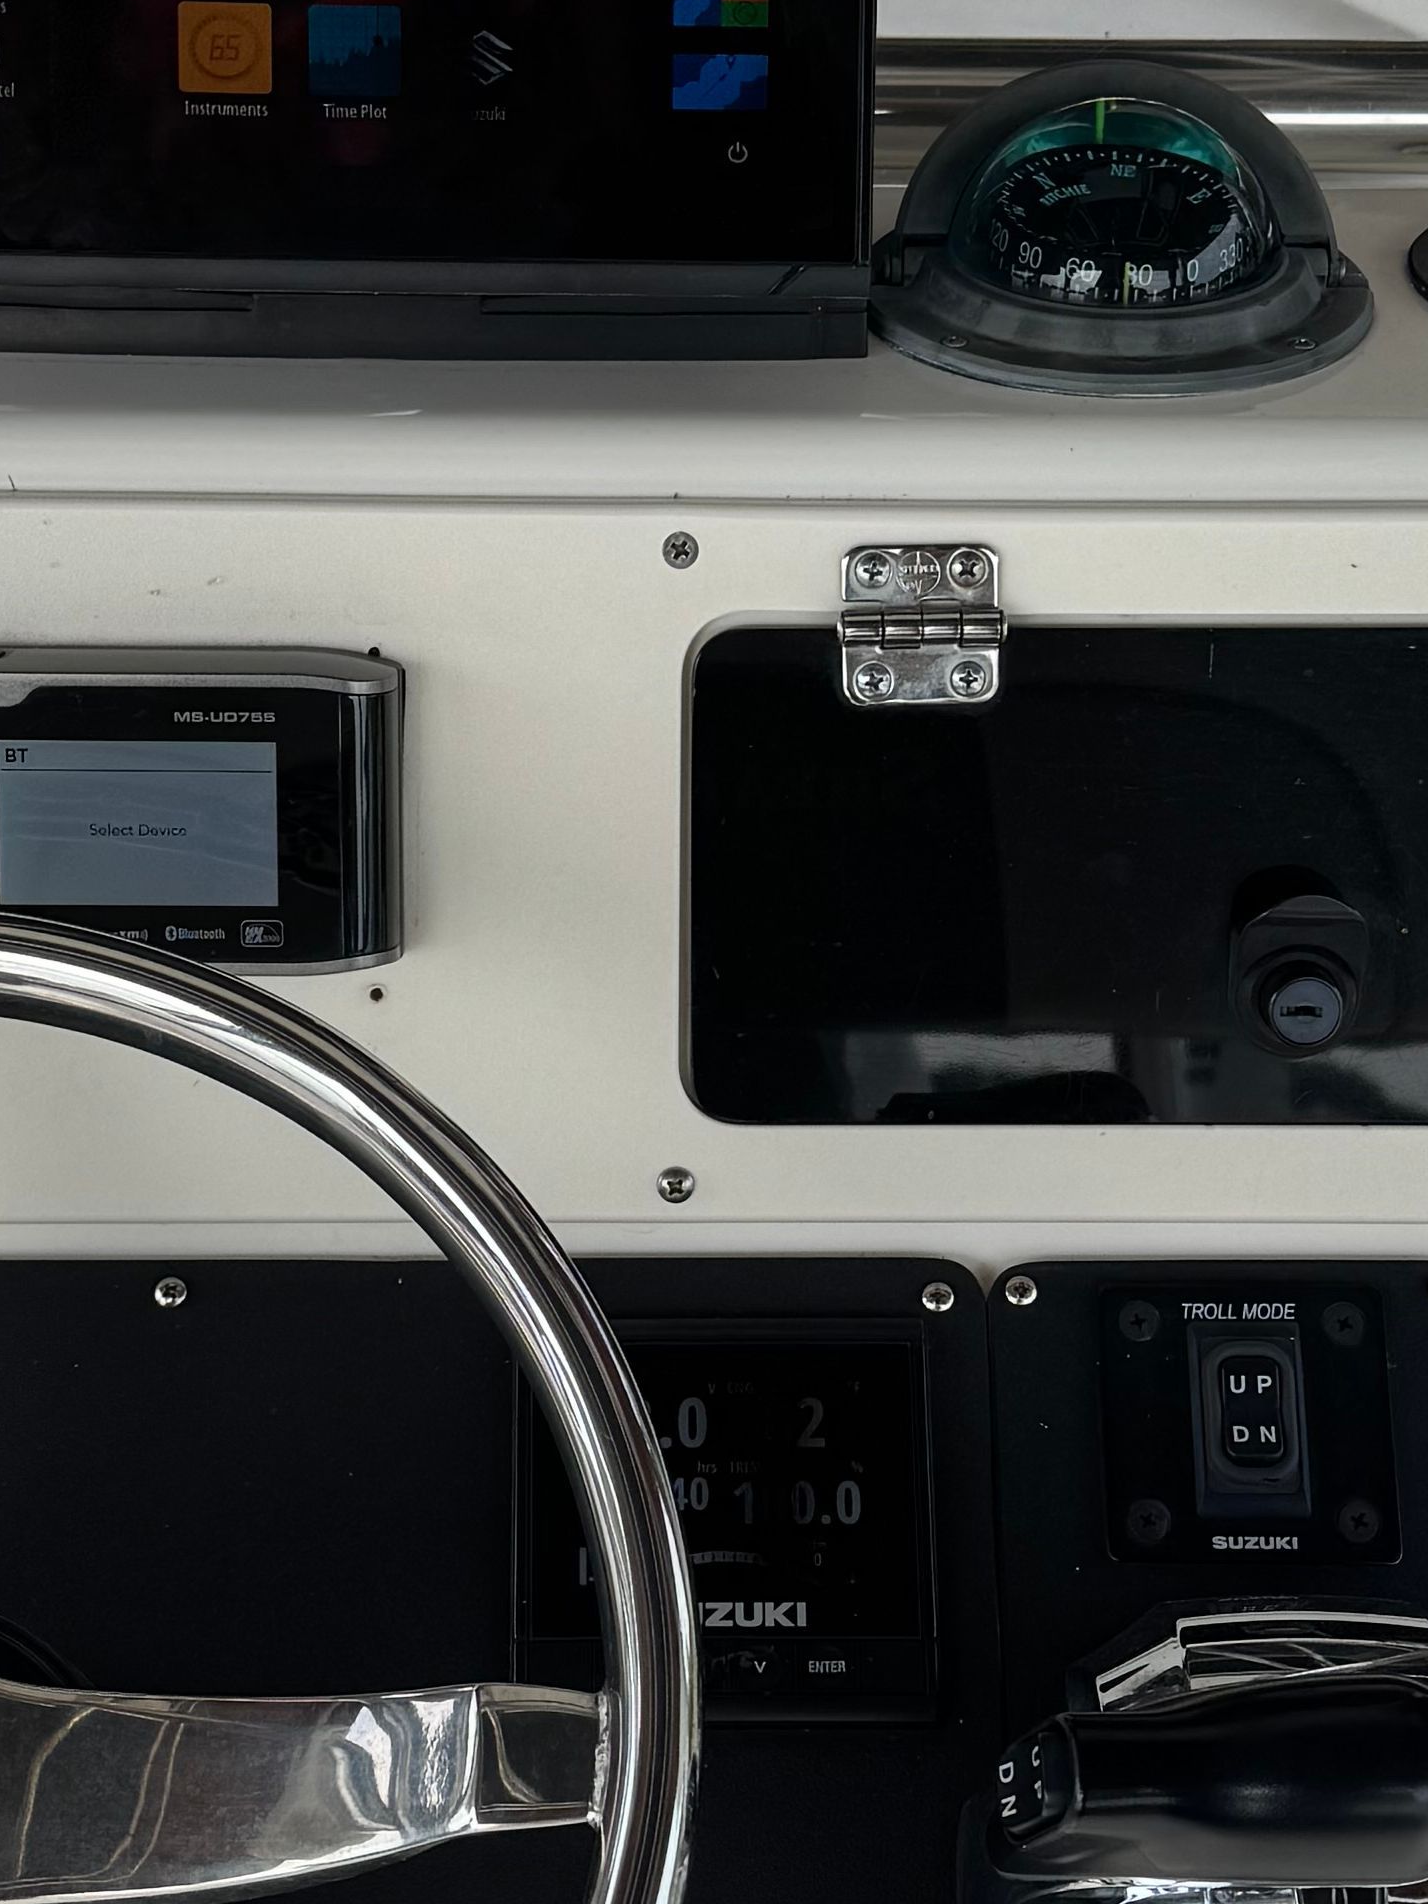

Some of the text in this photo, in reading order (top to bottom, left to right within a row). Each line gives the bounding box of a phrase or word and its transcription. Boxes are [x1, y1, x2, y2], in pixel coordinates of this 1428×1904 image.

[184, 99, 269, 119] Instruments
[322, 103, 388, 120] Time Plot
[1109, 163, 1138, 178] NE
[1032, 171, 1056, 191] N
[1017, 240, 1043, 270] 90
[1065, 256, 1096, 281] 60
[1186, 258, 1199, 283] 0
[173, 711, 276, 724] MS-UD755
[4, 748, 29, 764] BT
[89, 822, 187, 838] Select Device
[178, 926, 226, 941] Bluetooth
[1181, 1302, 1296, 1321] TROLL MODE
[1229, 1374, 1273, 1394] UP
[1232, 1425, 1277, 1444] DN
[1212, 1535, 1299, 1550] SUZUKI
[699, 1600, 807, 1628] ZUKI
[807, 1658, 847, 1674] ENTER
